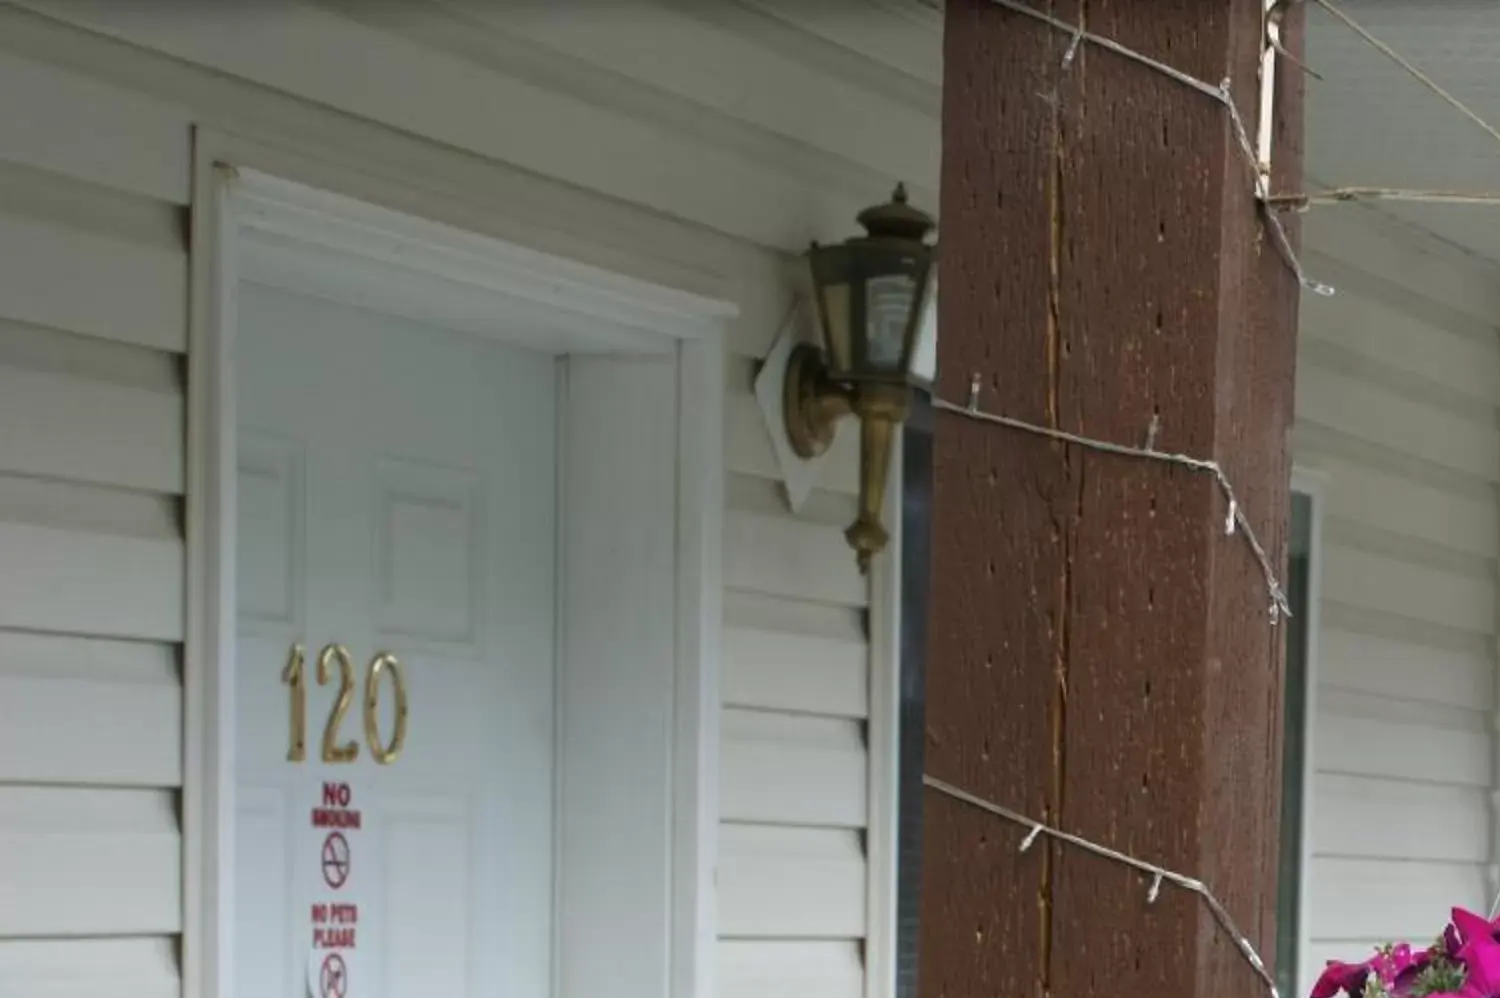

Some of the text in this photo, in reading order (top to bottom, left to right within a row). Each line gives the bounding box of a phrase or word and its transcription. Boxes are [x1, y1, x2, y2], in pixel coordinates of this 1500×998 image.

[281, 643, 407, 766] 120
[322, 780, 351, 807] NO
[311, 902, 358, 923] NO PETS
[312, 927, 356, 949] PLEASE
